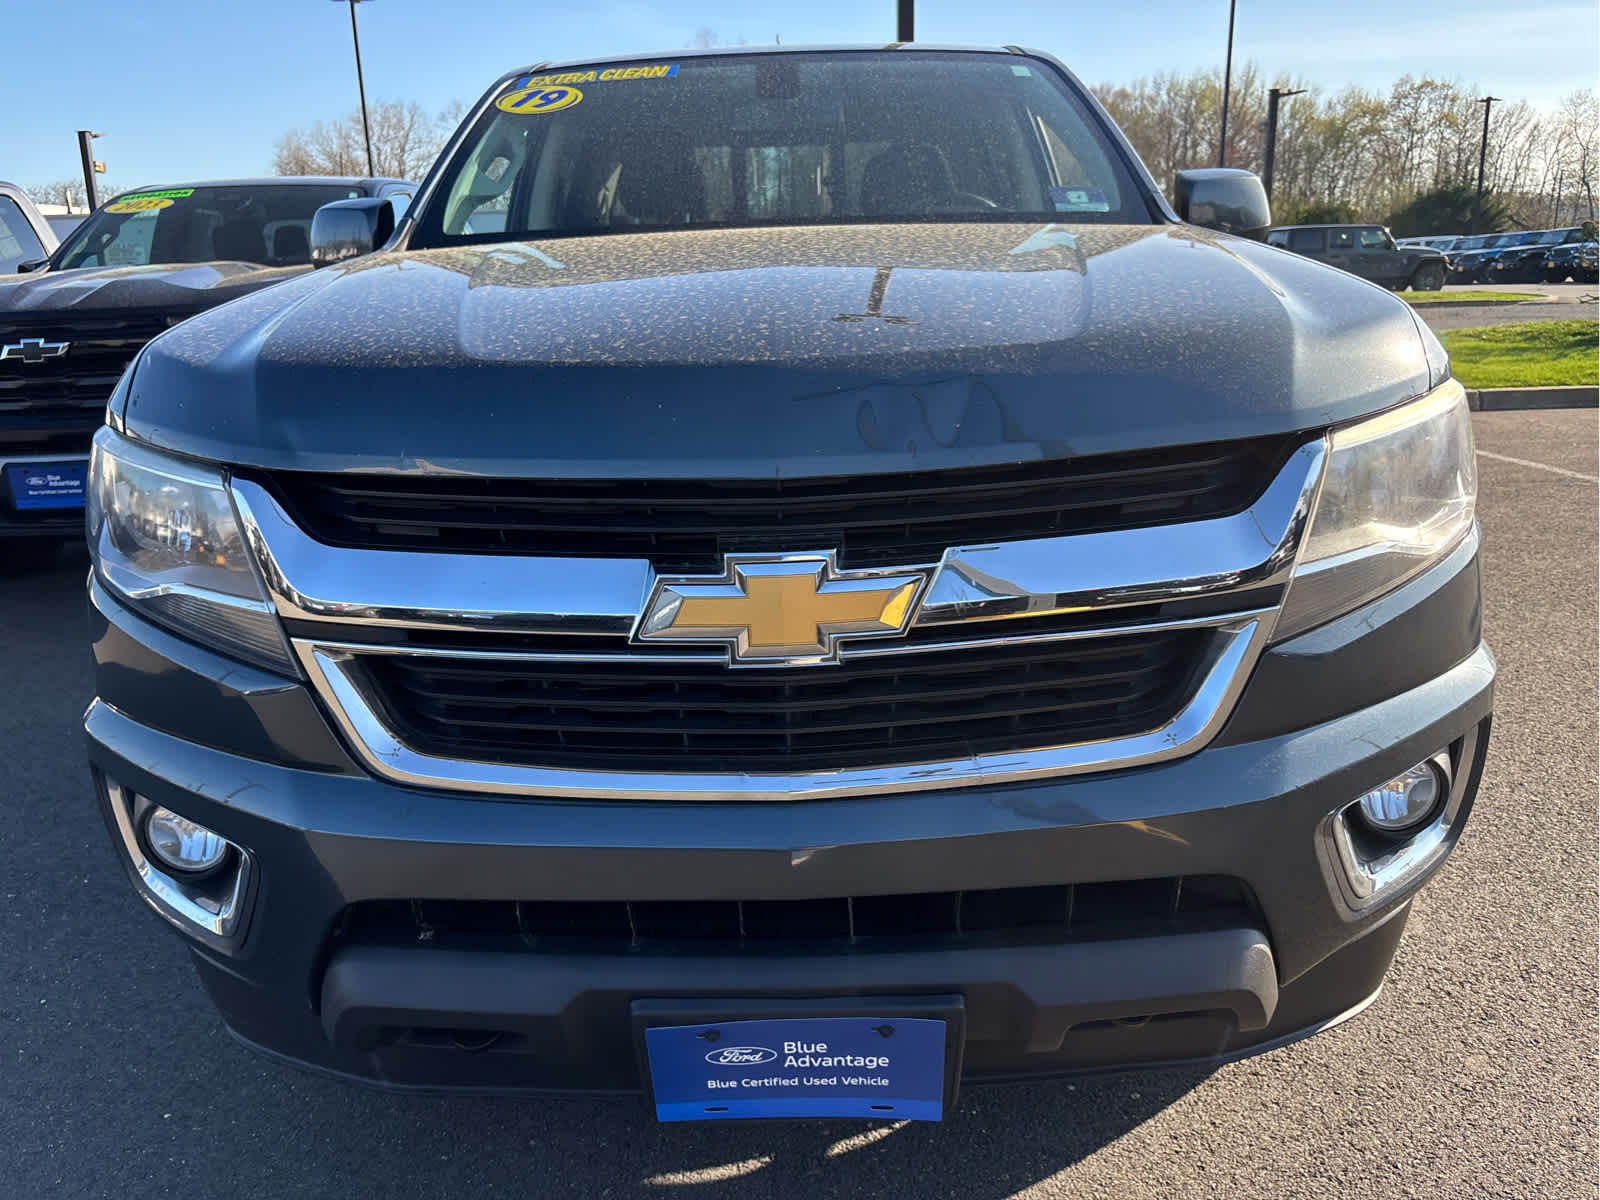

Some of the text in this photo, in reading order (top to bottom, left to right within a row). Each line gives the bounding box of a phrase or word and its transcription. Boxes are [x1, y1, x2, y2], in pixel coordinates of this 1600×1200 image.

[526, 65, 671, 88] EXTRA CLEAN
[511, 89, 569, 108] 19
[783, 1040, 828, 1054] Blue
[719, 1049, 764, 1063] Ford
[783, 1054, 890, 1069] Advantage
[707, 1076, 890, 1089] Blue Certified Used Vehicle
